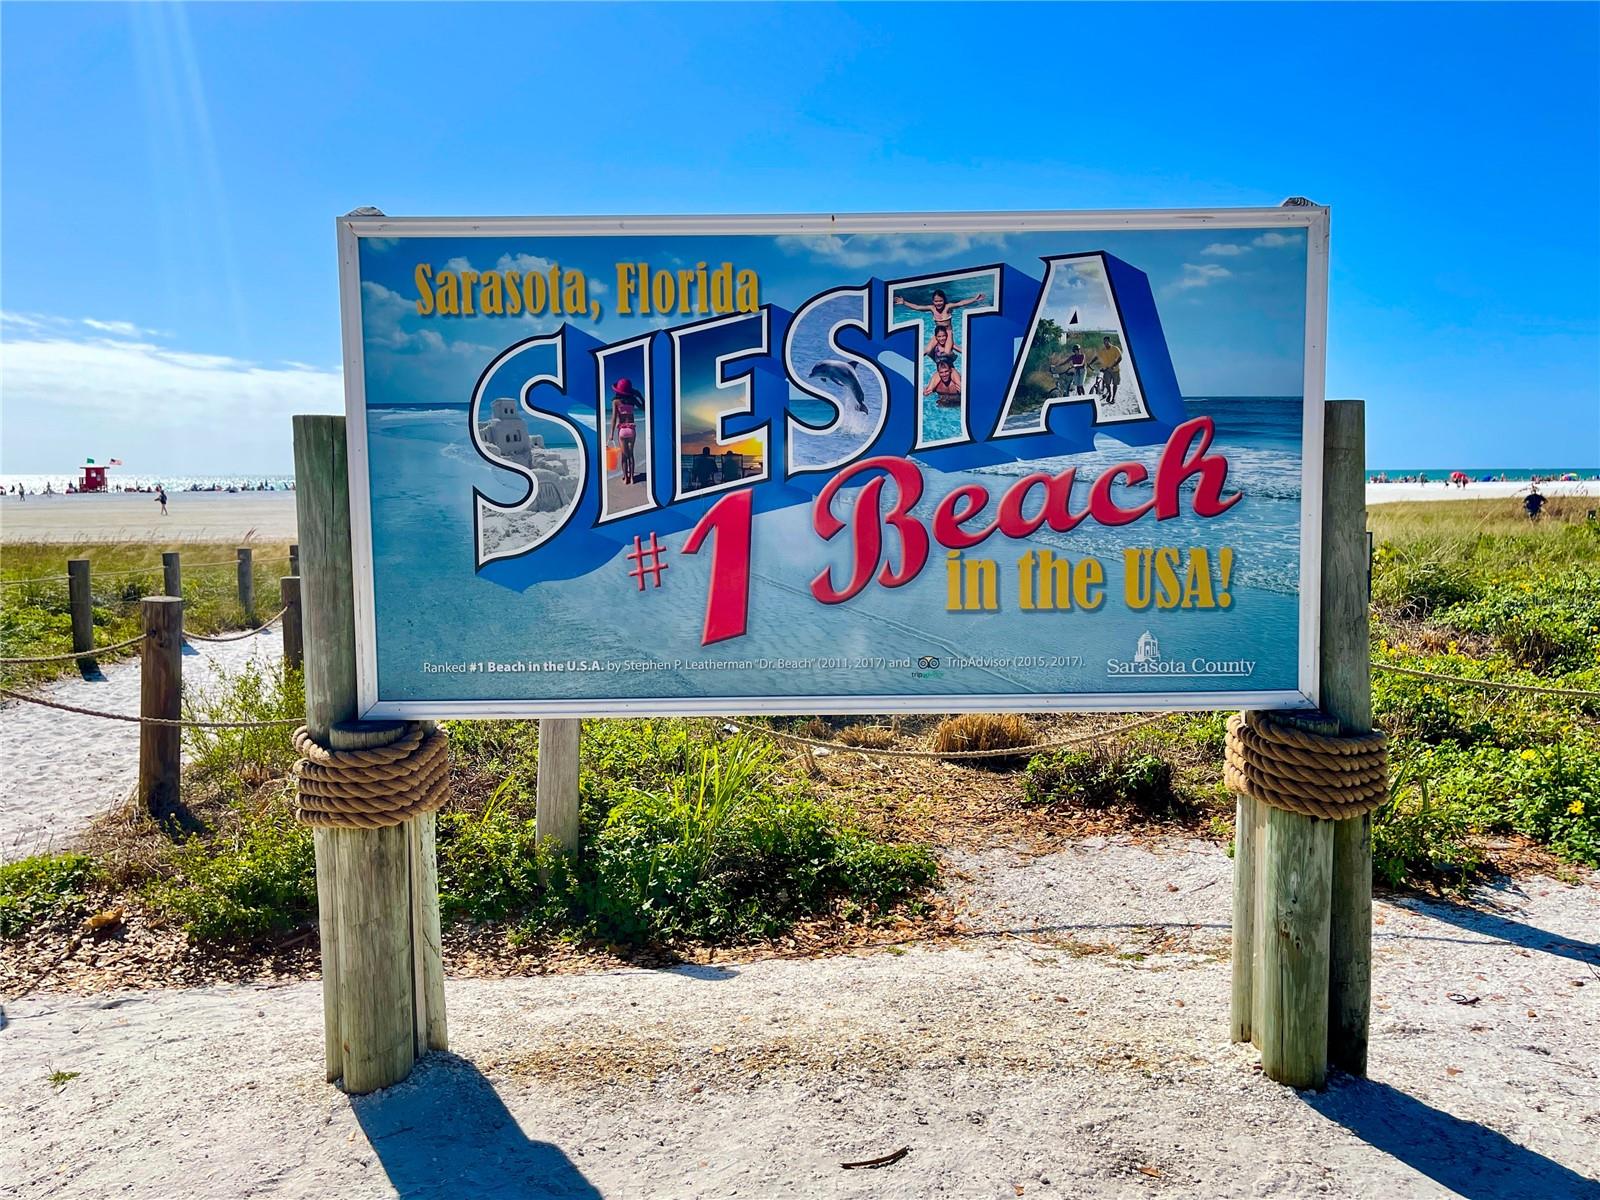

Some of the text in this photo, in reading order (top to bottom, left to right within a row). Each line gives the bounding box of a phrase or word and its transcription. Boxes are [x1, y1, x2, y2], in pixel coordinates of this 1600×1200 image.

[414, 262, 760, 320] Sarasota, Florida
[470, 250, 1152, 574] SIESTA
[810, 416, 1243, 605] Beach
[945, 547, 1234, 611] in the USA!
[423, 662, 466, 673] Ranked
[469, 662, 484, 673] #1
[487, 661, 526, 673] Beach
[528, 661, 540, 672] in
[543, 661, 564, 672] the
[567, 660, 605, 671] U.S.A.
[607, 660, 621, 673] by
[624, 660, 671, 672] Stephen
[675, 660, 682, 670] P.
[685, 659, 753, 670] Leatherman
[818, 657, 851, 669] (2011,
[855, 656, 886, 668] 2017)
[889, 657, 911, 668] and
[946, 656, 1010, 669] TripAdvisor
[1014, 656, 1049, 668] (2015,
[1051, 656, 1086, 668] 2017).
[1107, 658, 1256, 676] Sarasota County
